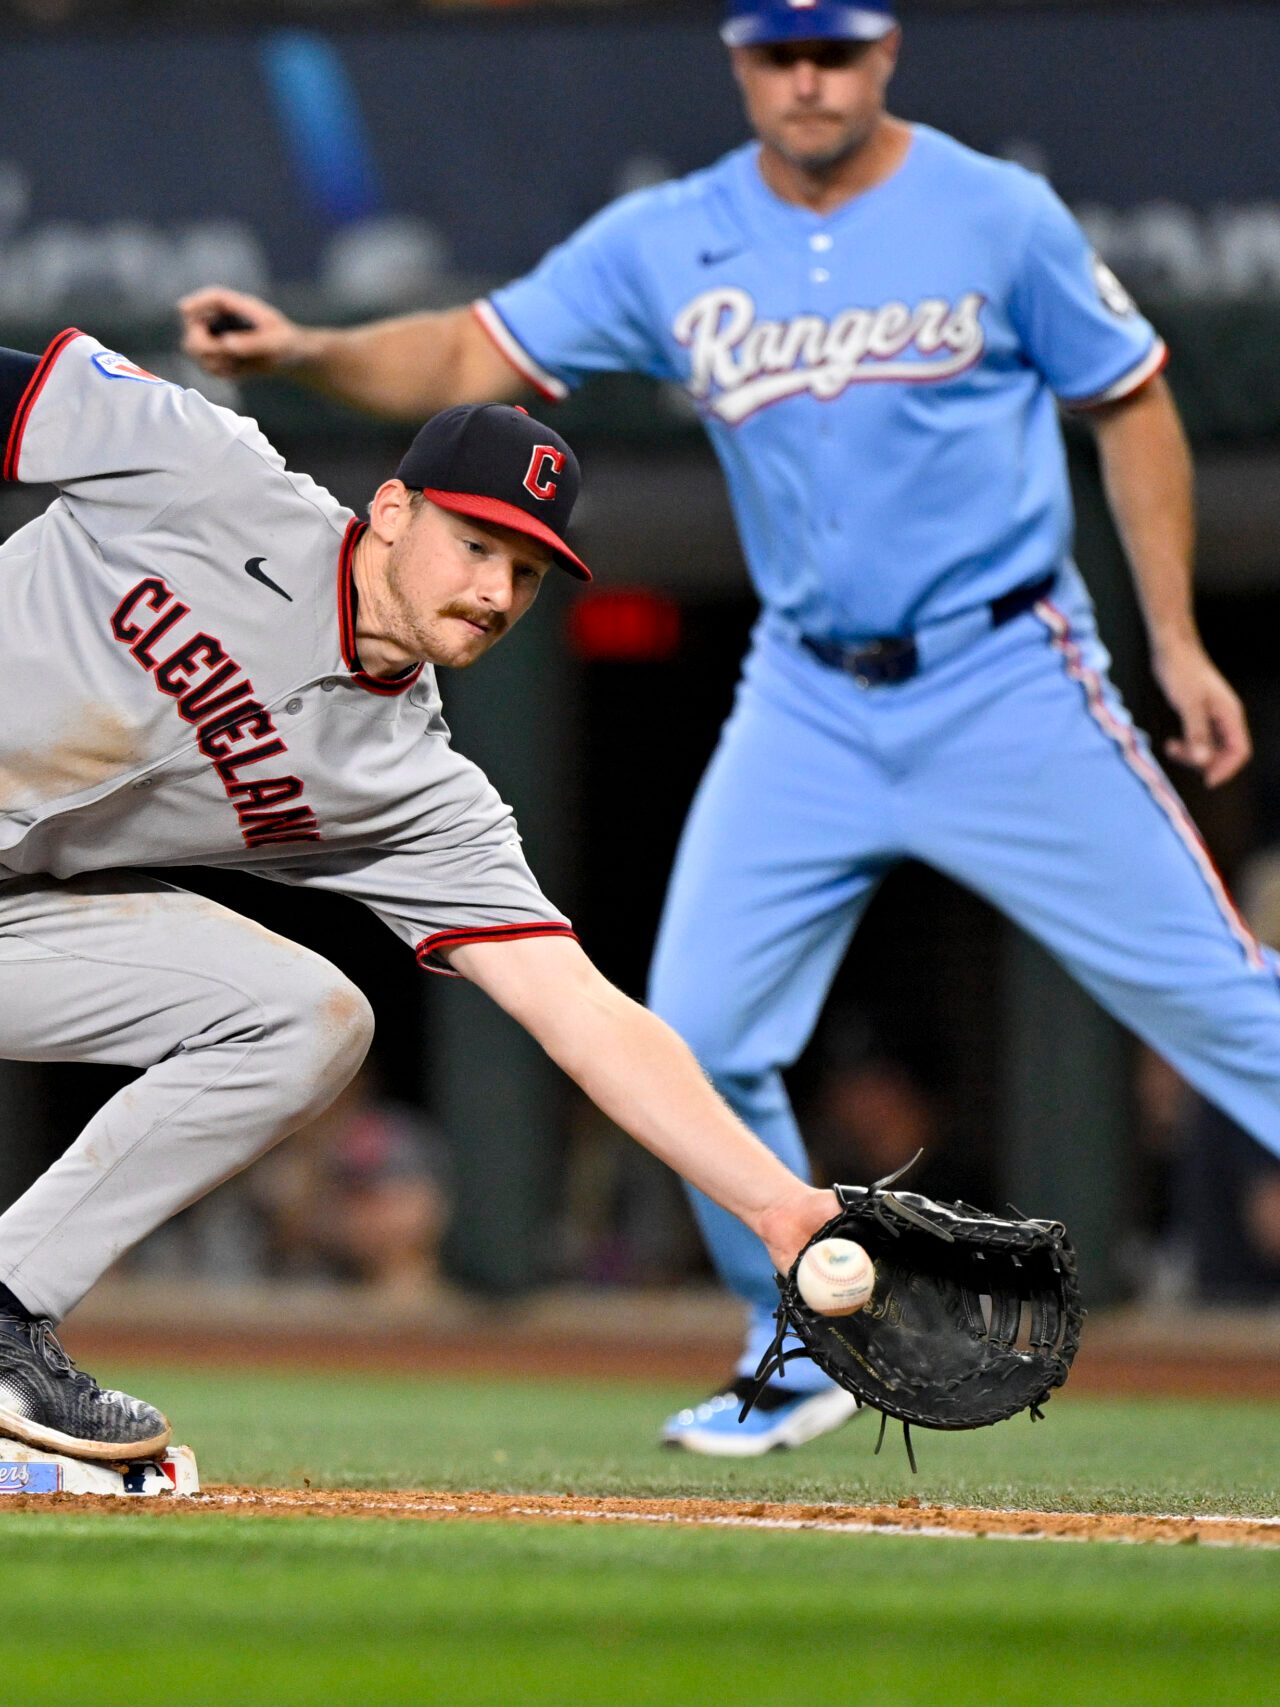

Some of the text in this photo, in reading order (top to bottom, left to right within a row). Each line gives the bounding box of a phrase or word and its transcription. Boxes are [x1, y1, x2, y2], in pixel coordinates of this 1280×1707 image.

[673, 287, 987, 425] Rangers
[522, 444, 566, 500] C
[109, 577, 324, 849] CLEVELAN
